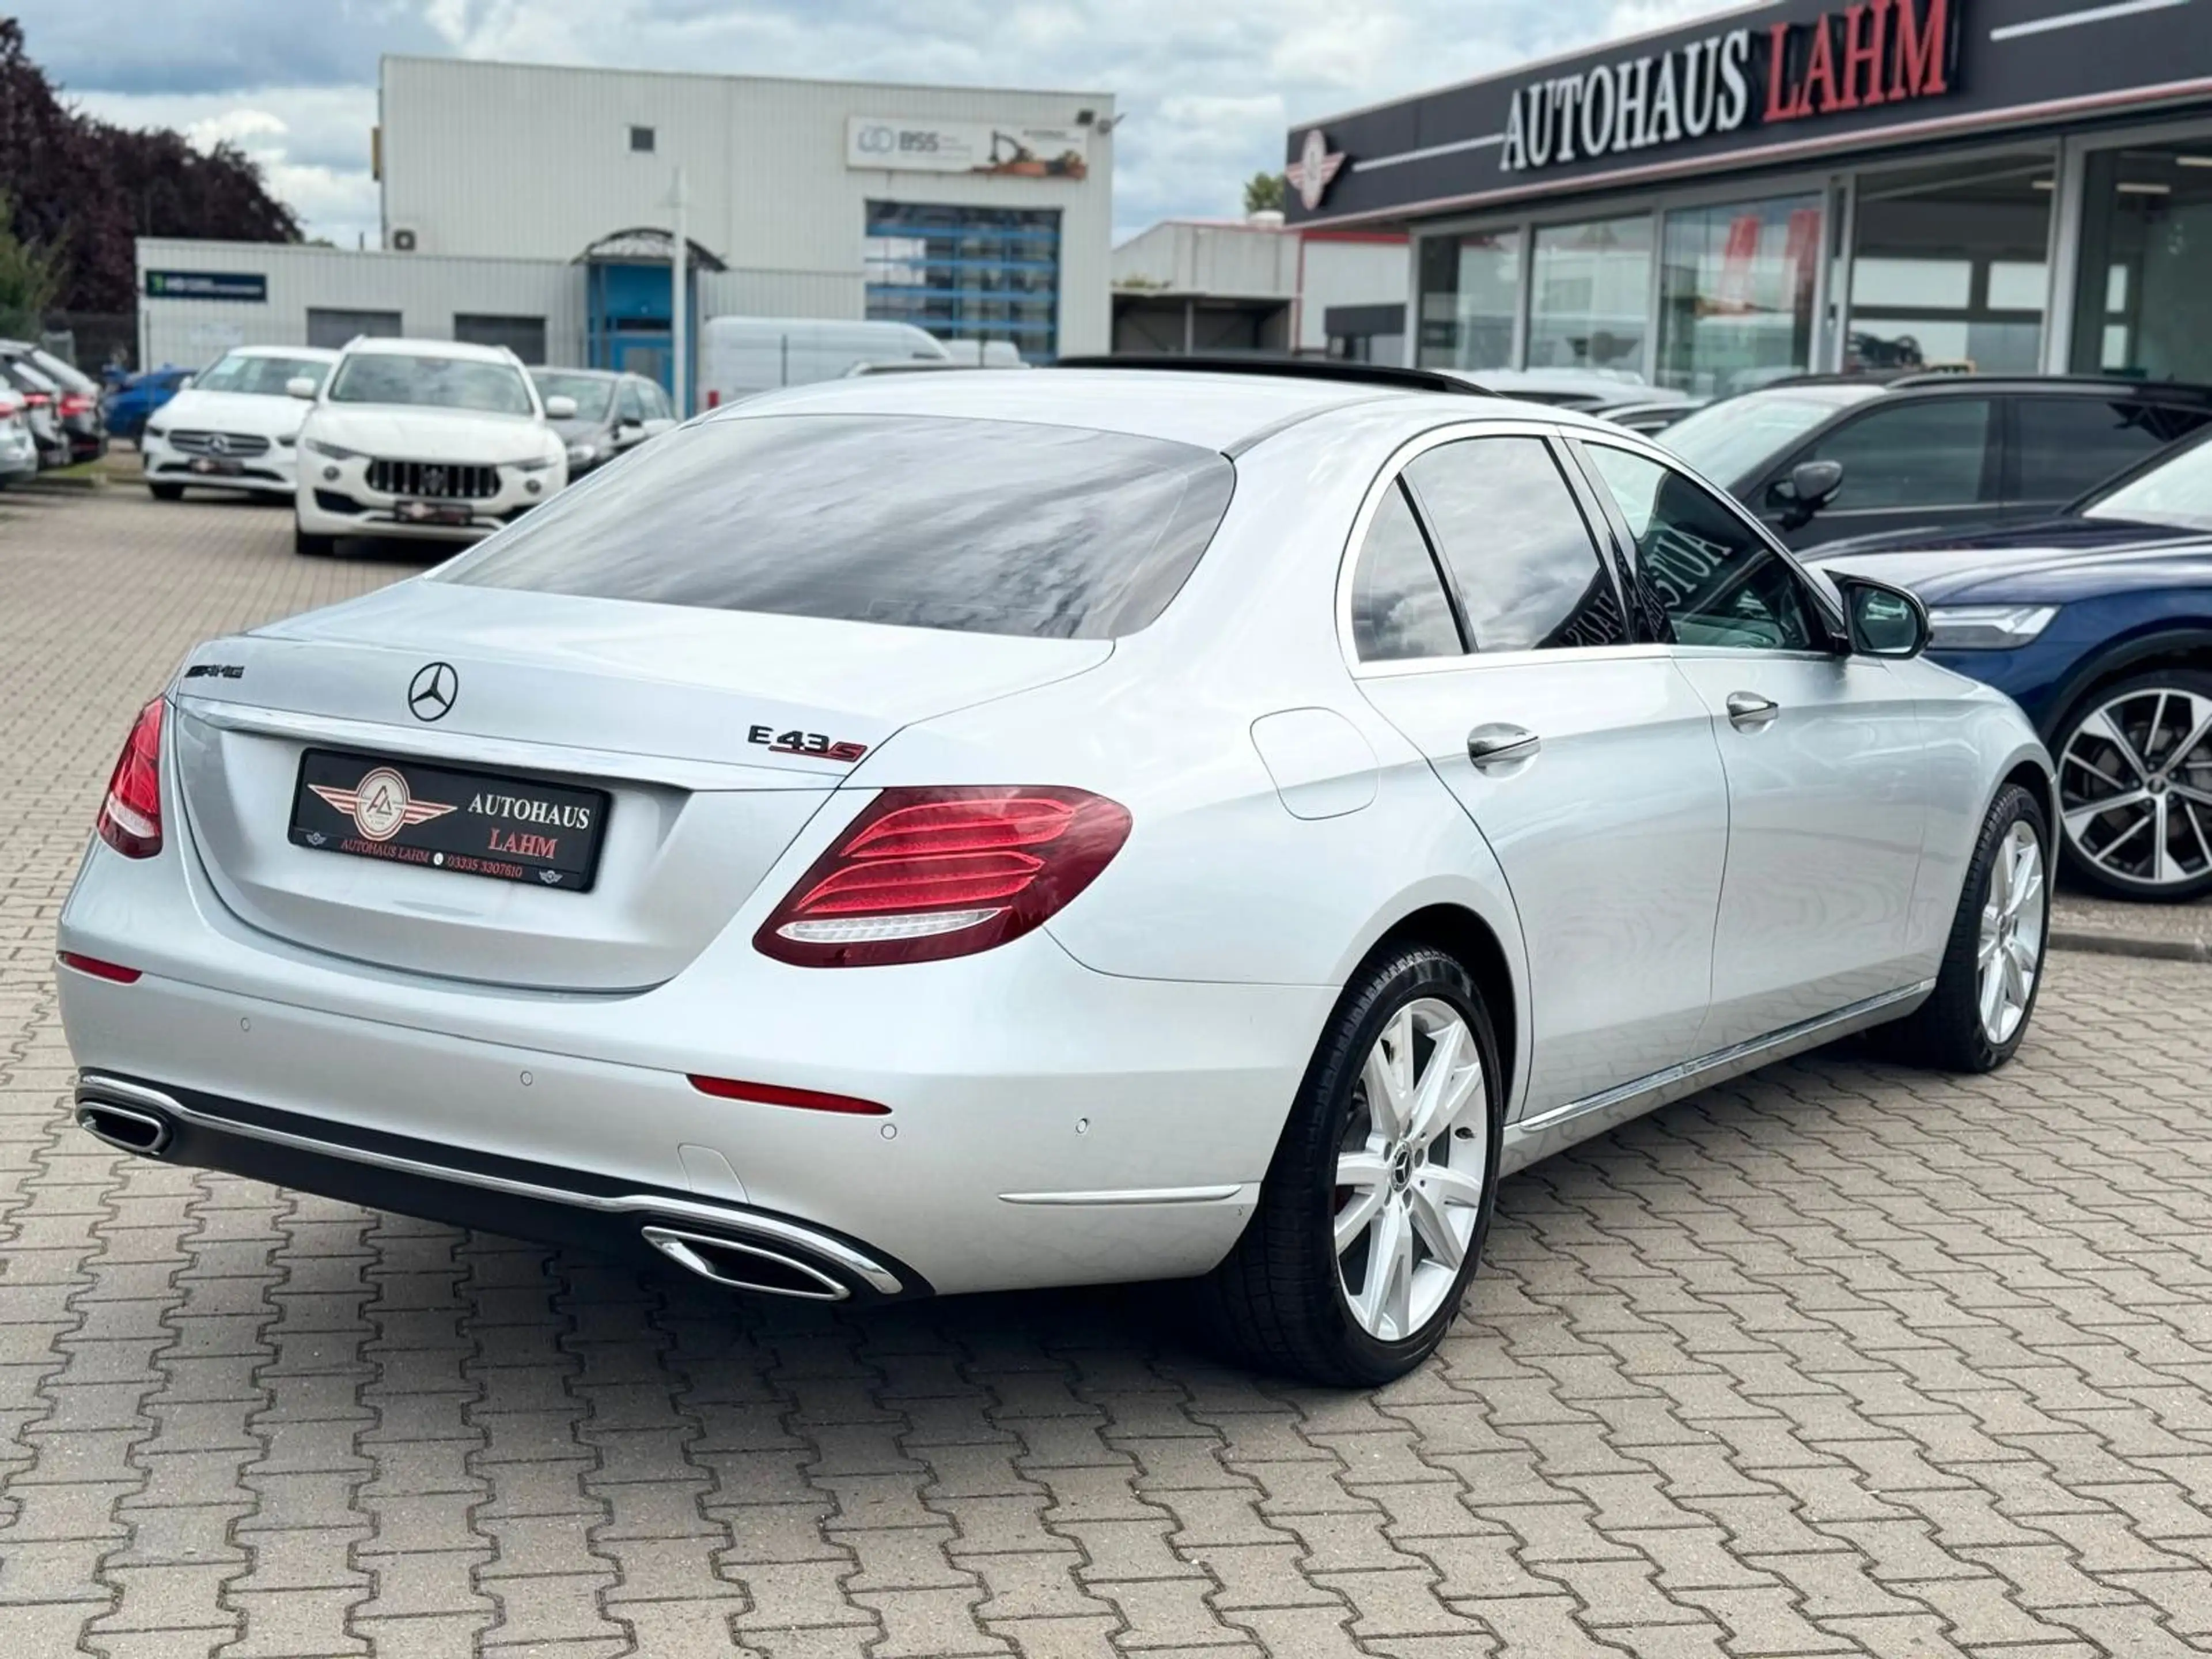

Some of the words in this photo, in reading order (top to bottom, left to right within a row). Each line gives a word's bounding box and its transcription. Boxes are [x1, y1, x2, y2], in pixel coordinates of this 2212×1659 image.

[1499, 28, 1749, 172] AUTOHAUS
[1763, 0, 1948, 123] LAHM
[467, 793, 590, 830] AUTOHAUS
[340, 839, 397, 858] AUTOHAUS
[398, 847, 430, 863] LAHM
[488, 827, 558, 859] LAHM
